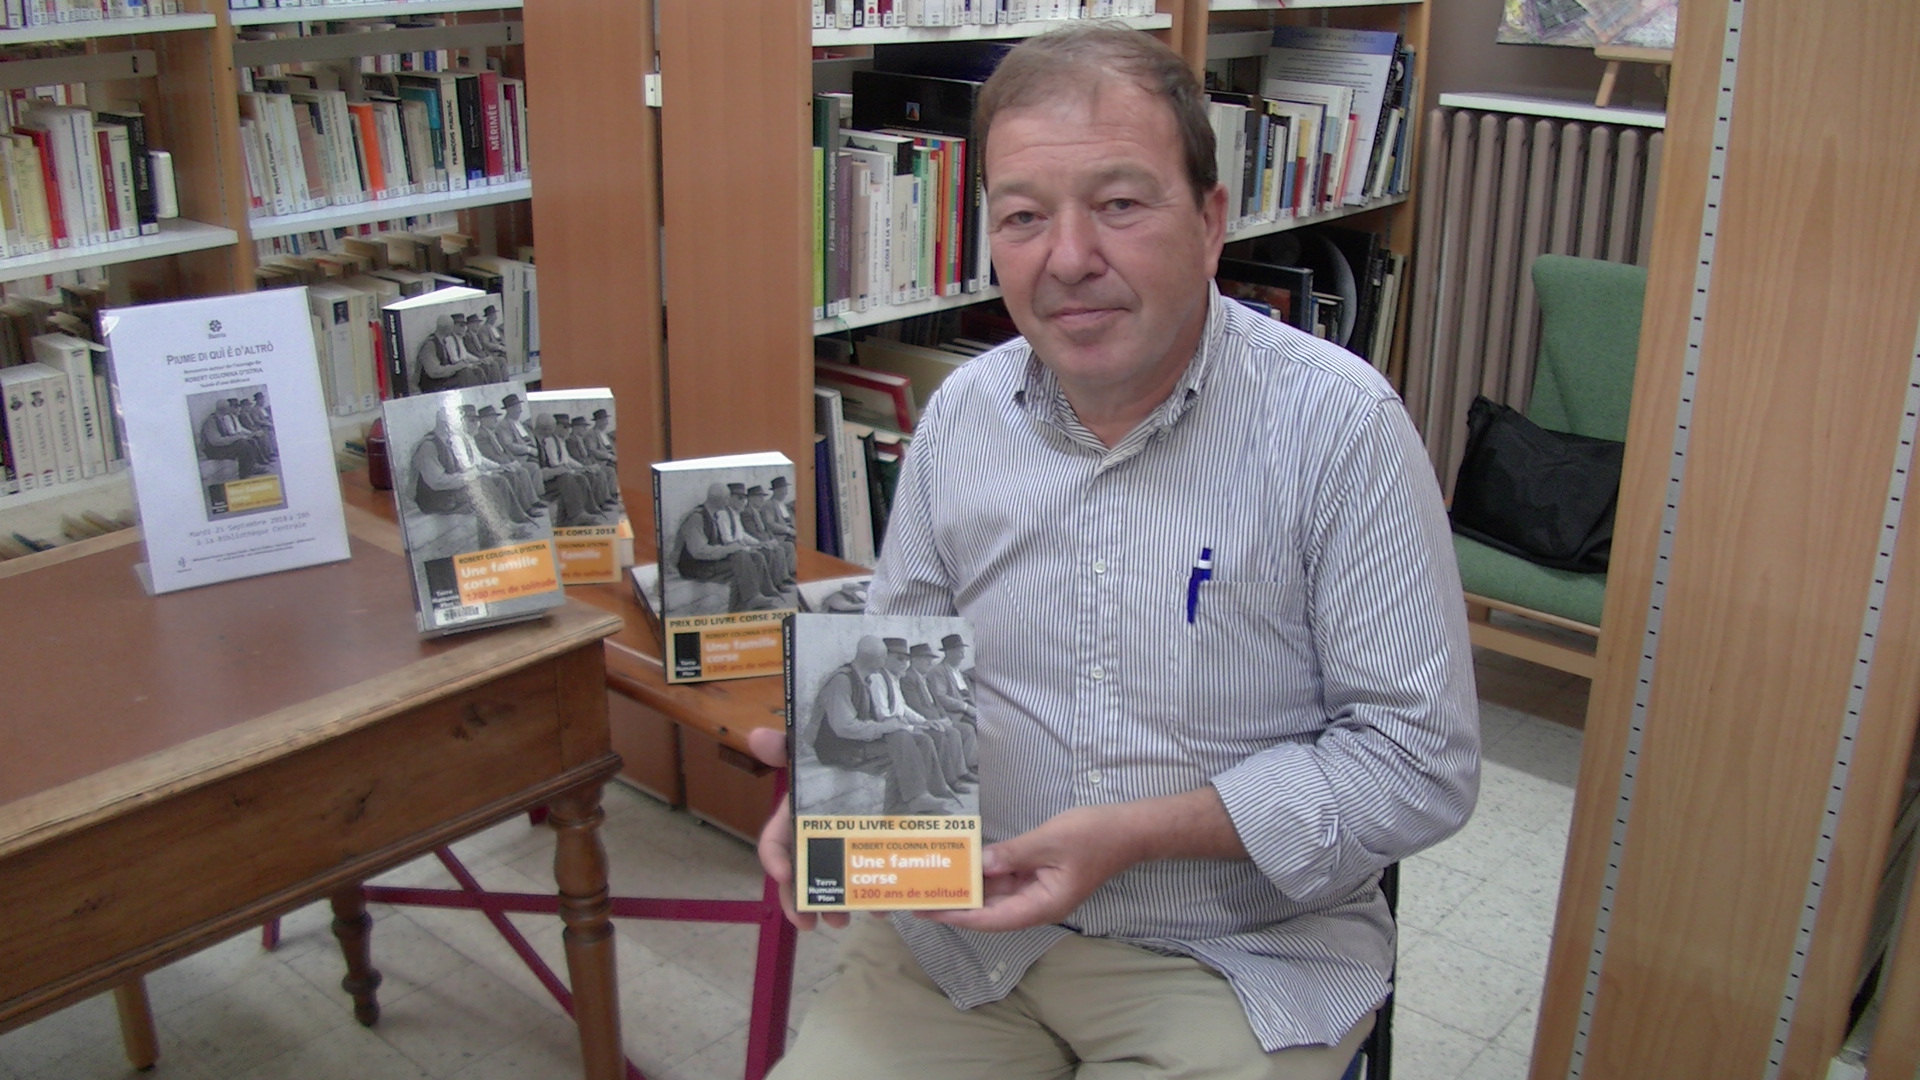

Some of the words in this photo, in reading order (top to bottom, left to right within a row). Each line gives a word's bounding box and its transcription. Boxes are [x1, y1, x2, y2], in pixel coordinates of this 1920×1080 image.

[488, 104, 500, 150] MÉRIMÉE
[198, 352, 208, 361] DI
[566, 529, 593, 537] CORSE
[596, 528, 616, 536] 2018
[459, 554, 485, 565] ROBERT
[485, 548, 518, 560] COLONNA
[519, 543, 547, 555] D'ISTRIA
[461, 564, 487, 578] Une
[491, 556, 539, 573] famille
[463, 576, 499, 591] corse
[491, 588, 506, 598] ans
[508, 585, 520, 594] de
[521, 579, 557, 593] solitude
[670, 619, 691, 628] PRIX
[694, 618, 708, 626] DU
[711, 617, 736, 625] LIVRE
[740, 614, 769, 623] CORSE
[733, 637, 777, 649] famille
[705, 653, 740, 663] corse
[803, 820, 833, 830] PRIX
[837, 820, 855, 830] DU
[859, 820, 895, 830] LIVRE
[899, 820, 940, 830] CORSE
[944, 820, 976, 830] 2018
[851, 842, 884, 850] ROBERT
[886, 842, 929, 850] COLONNA
[930, 841, 965, 849] D'ISTRIA
[852, 855, 885, 868] Une
[890, 854, 951, 868] famille
[815, 878, 837, 886] Terre
[851, 873, 898, 885] corse
[808, 887, 844, 895] Humaine
[884, 890, 903, 898] ans
[907, 889, 921, 898] de
[925, 888, 970, 898] solitude
